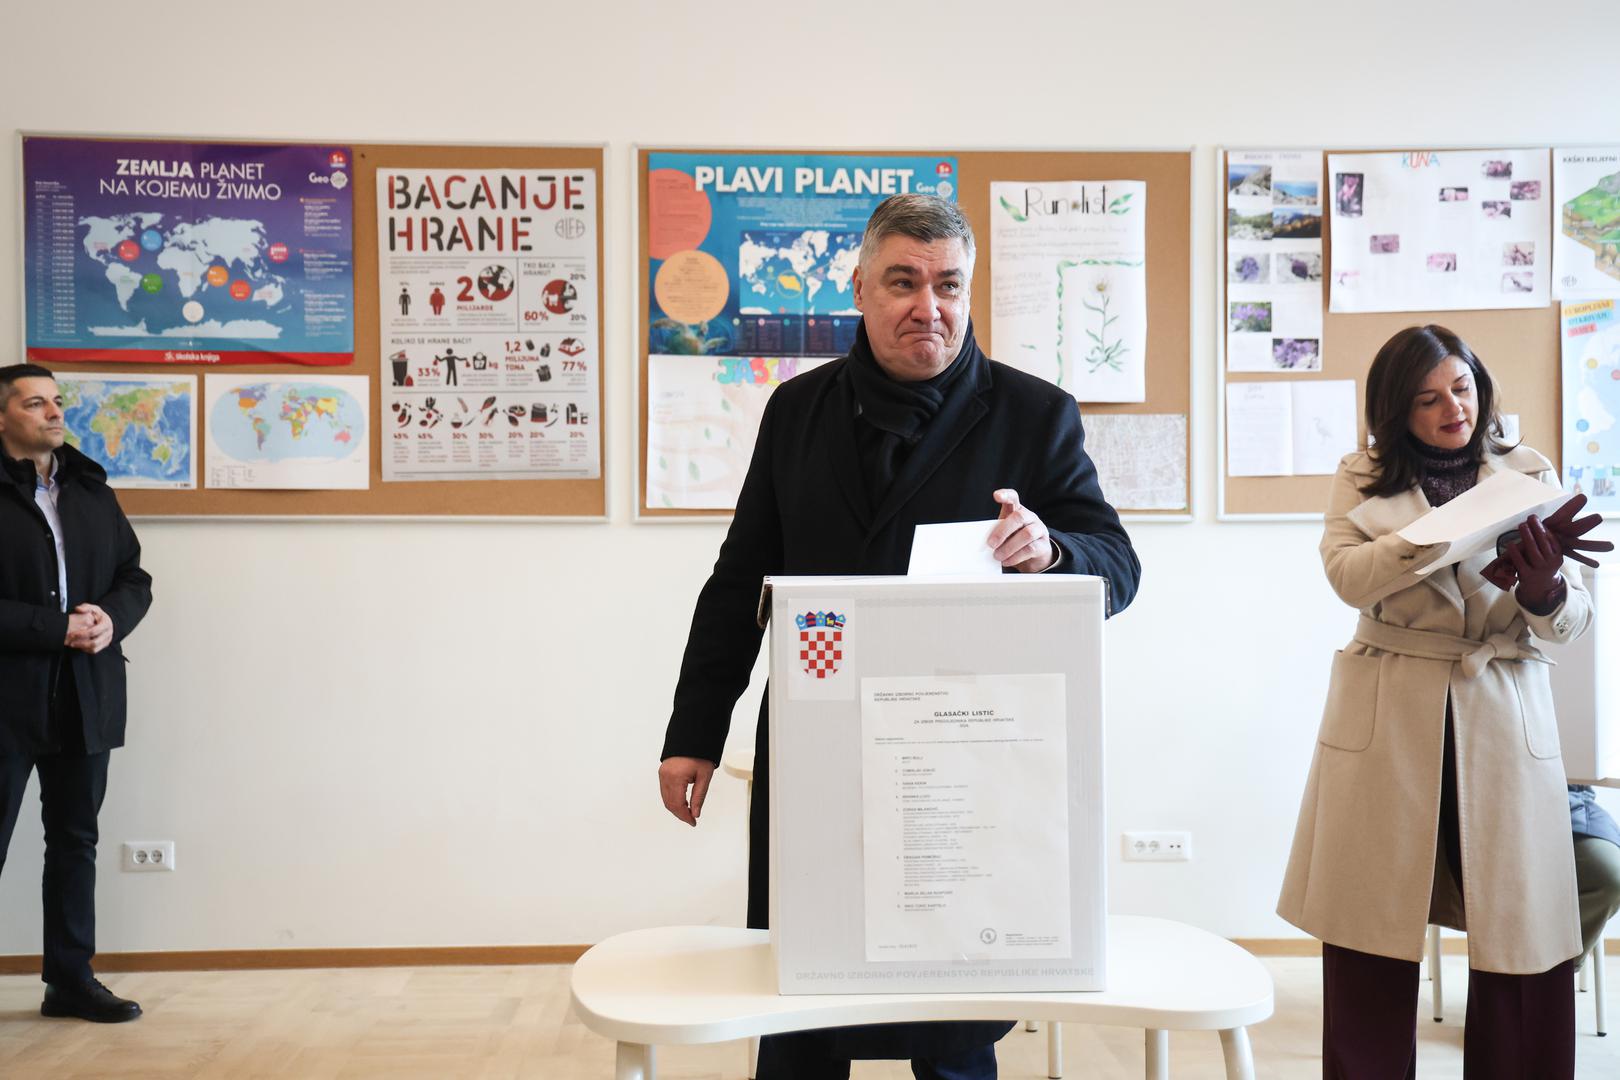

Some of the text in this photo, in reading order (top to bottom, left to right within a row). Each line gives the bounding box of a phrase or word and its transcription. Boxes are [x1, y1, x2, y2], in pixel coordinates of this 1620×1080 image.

[116, 159, 265, 180] ZEMLJA PLANET
[308, 171, 329, 184] Geo
[695, 166, 914, 195] PLAVI PLANET
[100, 178, 282, 200] NA KOJEMU ŽIVIMO
[388, 175, 585, 210] BACANJE
[916, 182, 935, 193] Geo
[389, 216, 533, 252] HRANE
[524, 310, 549, 321] 60%
[391, 337, 415, 345] KOLIKO
[505, 341, 521, 354] 1,2
[562, 361, 587, 371] 77%
